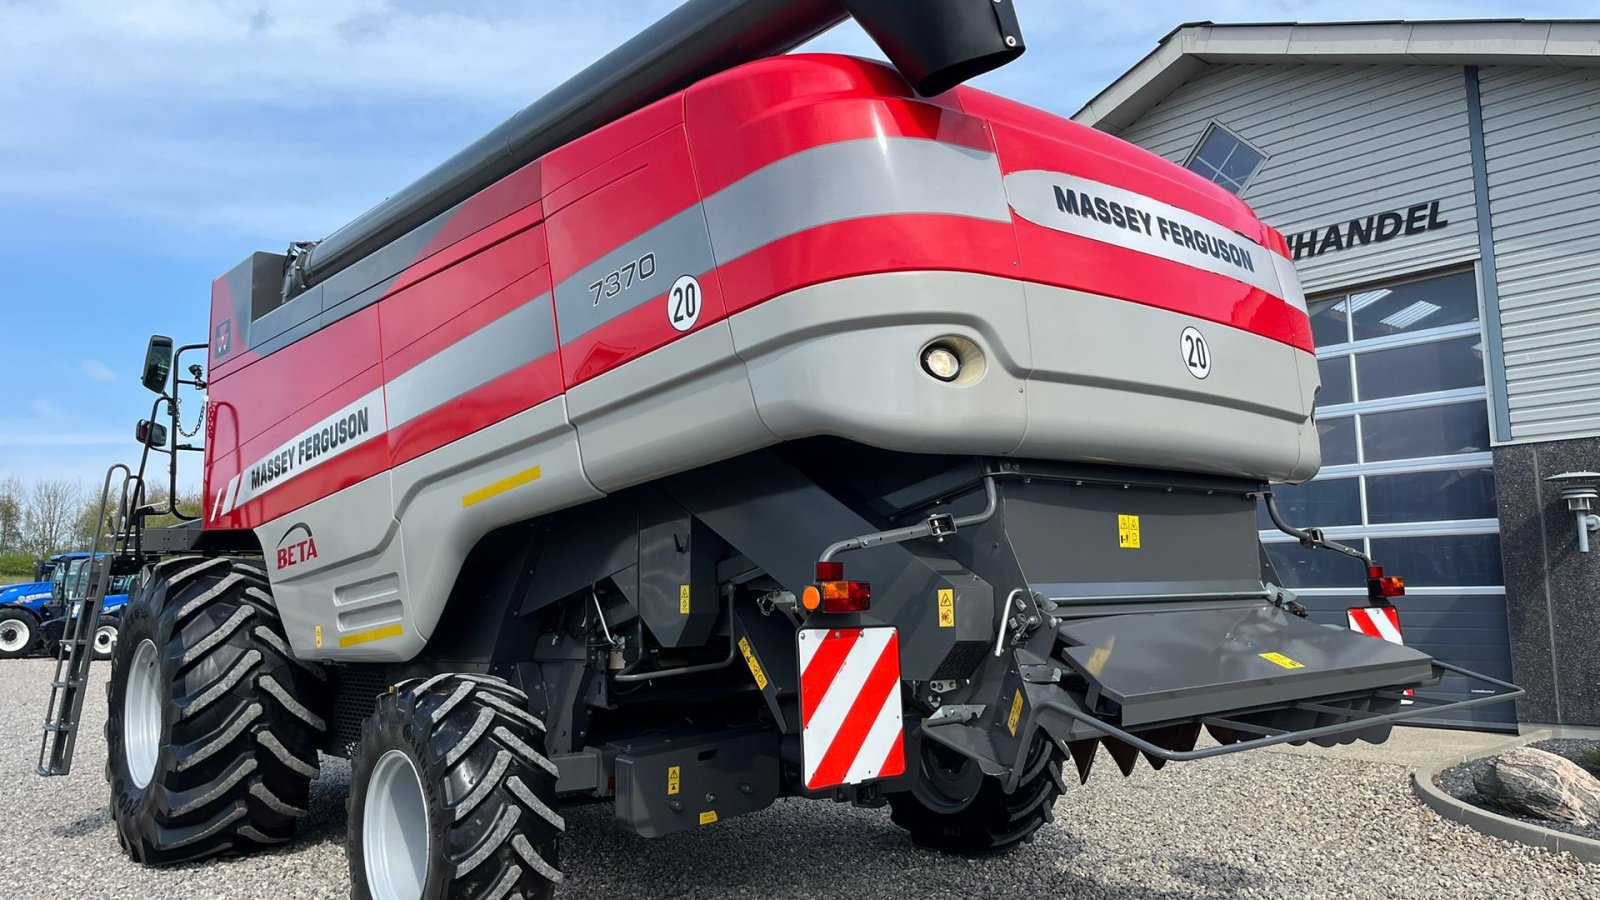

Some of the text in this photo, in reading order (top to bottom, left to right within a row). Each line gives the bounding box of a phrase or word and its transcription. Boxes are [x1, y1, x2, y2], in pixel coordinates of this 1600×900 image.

[1053, 185, 1255, 273] MASSEY FERGUSON
[589, 251, 656, 307] 7370
[673, 282, 696, 323] 20
[1185, 335, 1206, 369] 20
[250, 406, 369, 491] MASSEY FERGUSON
[276, 537, 318, 570] BETA
